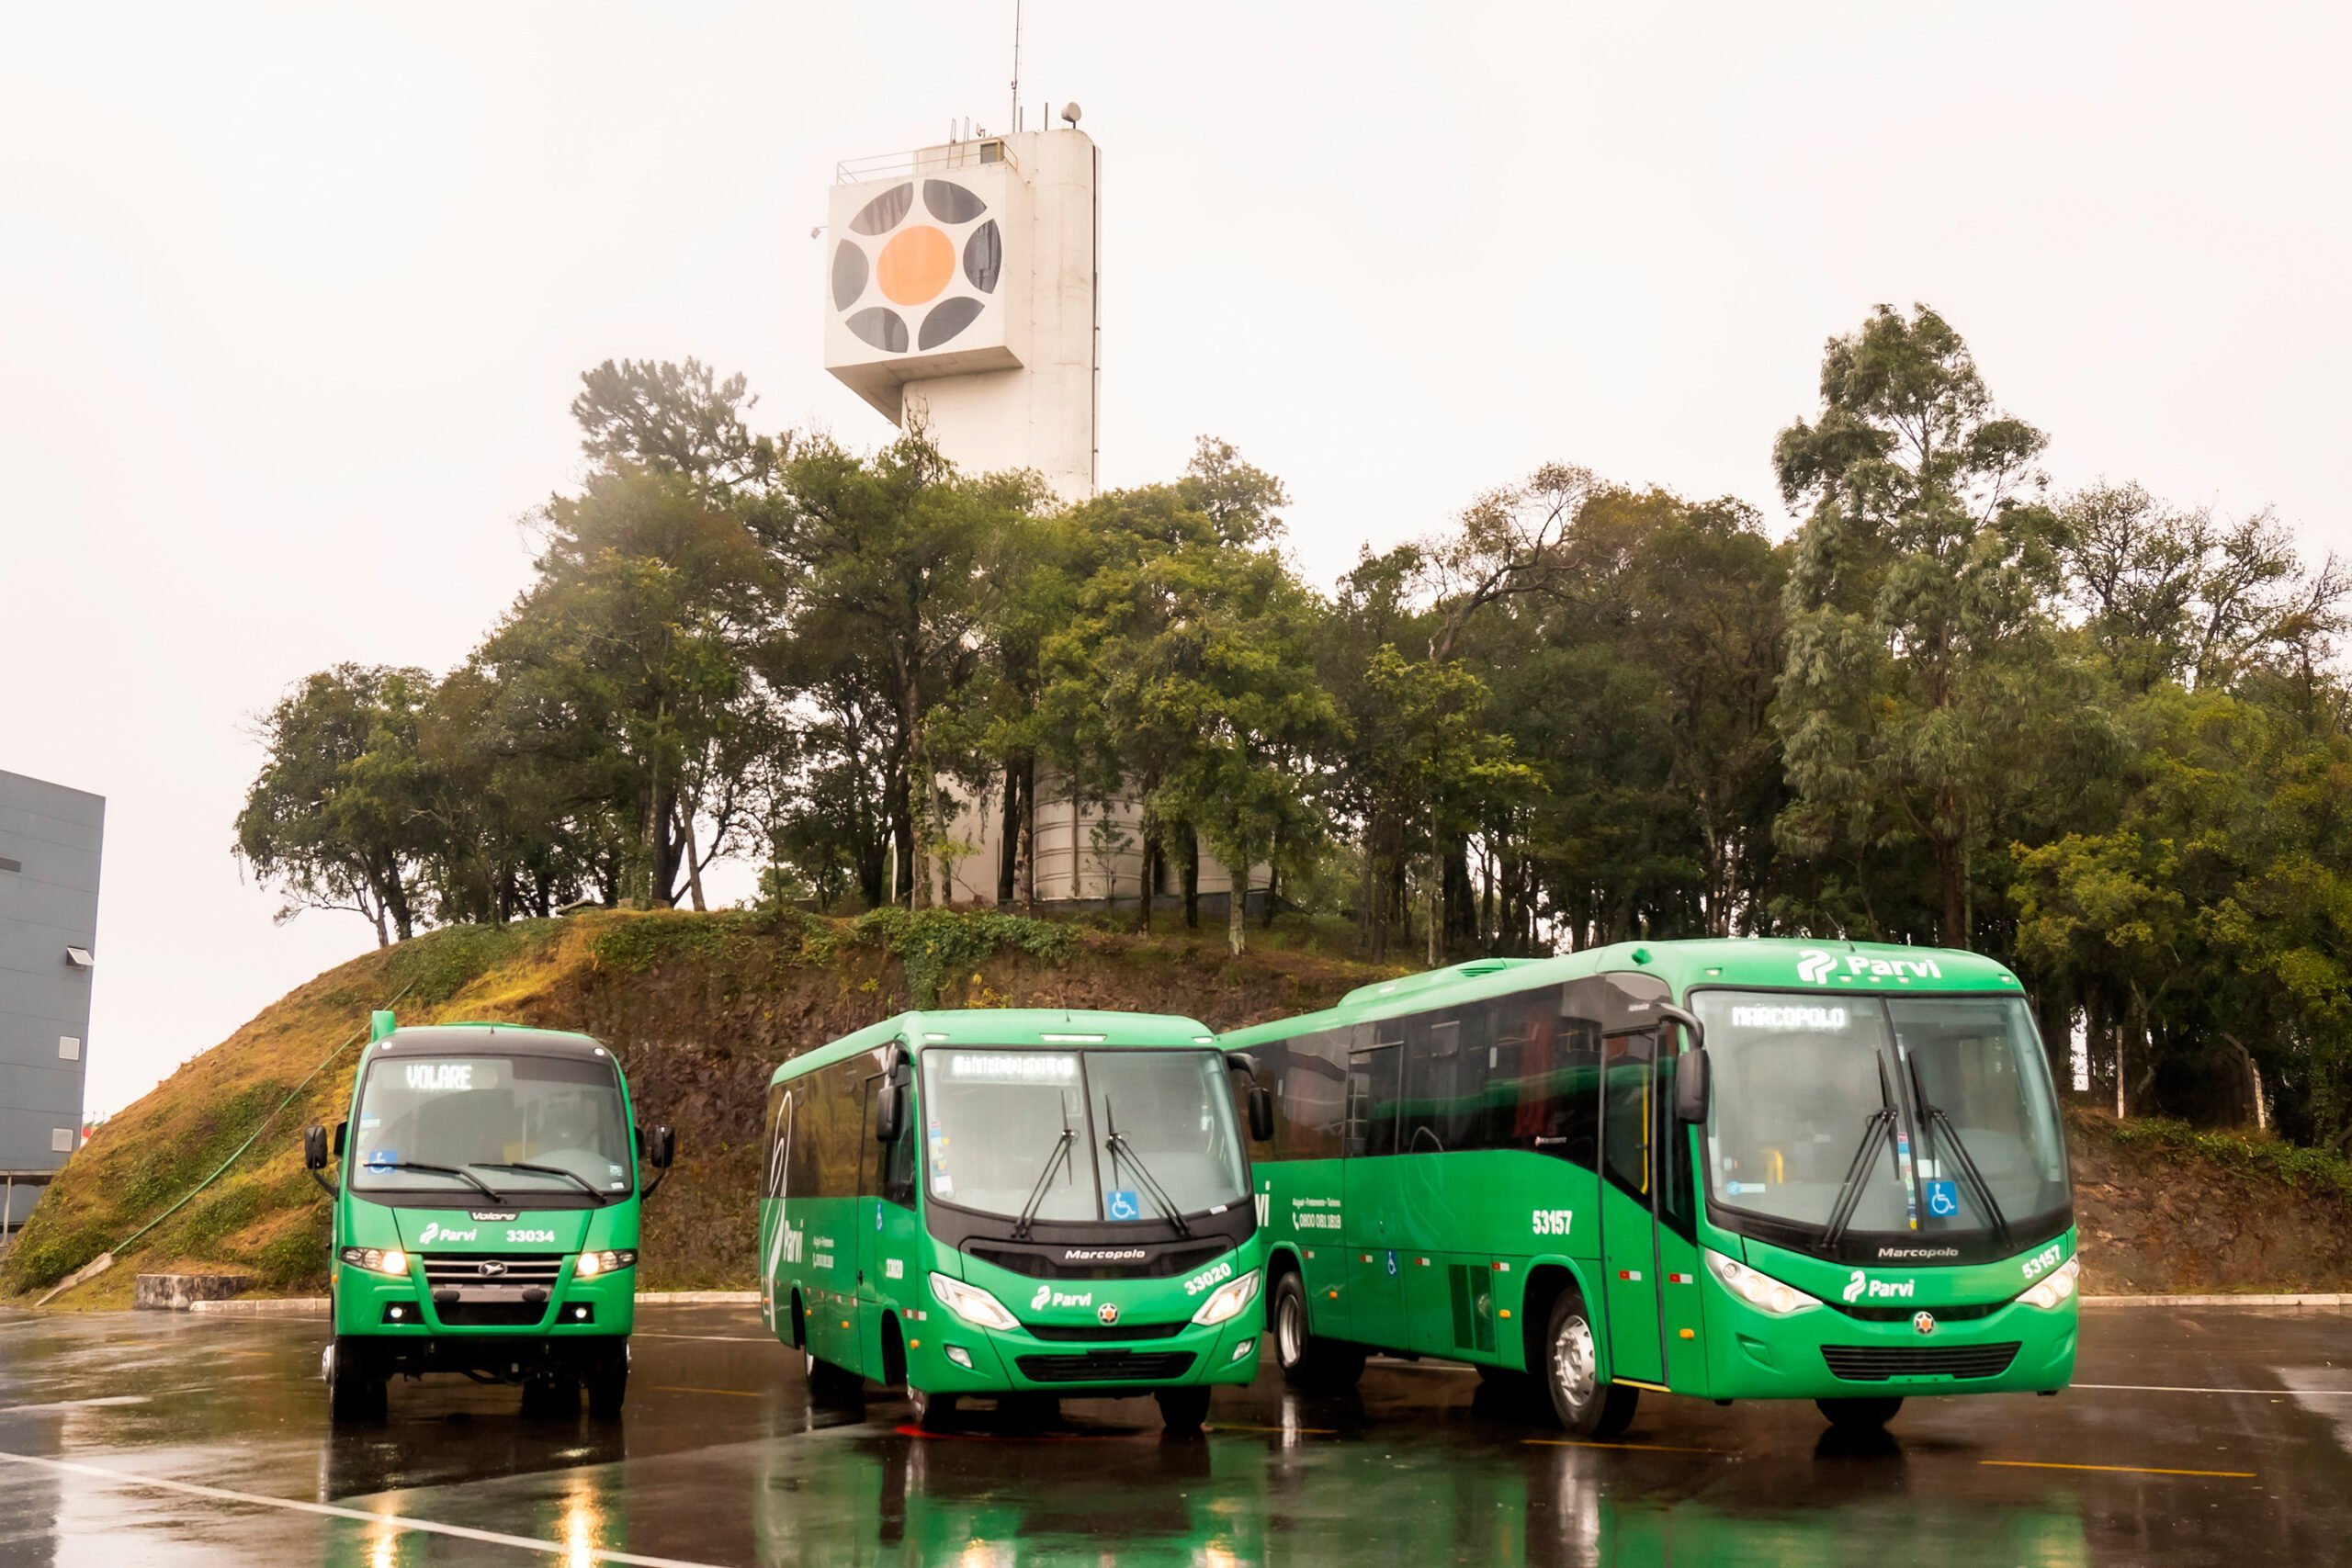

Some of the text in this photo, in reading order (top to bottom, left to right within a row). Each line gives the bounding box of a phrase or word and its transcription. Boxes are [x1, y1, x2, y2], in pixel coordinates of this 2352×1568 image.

[1845, 955, 1941, 978] Parvi
[1732, 1006, 1845, 1027] MARCOPOLO
[406, 1064, 472, 1089] VOLARE
[472, 1212, 516, 1221] Volare
[1532, 1210, 1573, 1235] 53157
[440, 1229, 478, 1241] Parvi
[506, 1230, 555, 1243] 33034
[1065, 1248, 1146, 1260] Marcopolo
[1878, 1247, 1959, 1258] Marcopolo
[2021, 1244, 2062, 1280] 53157
[1184, 1262, 1232, 1296] 33020
[1869, 1279, 1915, 1297] Parvi
[1053, 1292, 1091, 1306] Parvi
